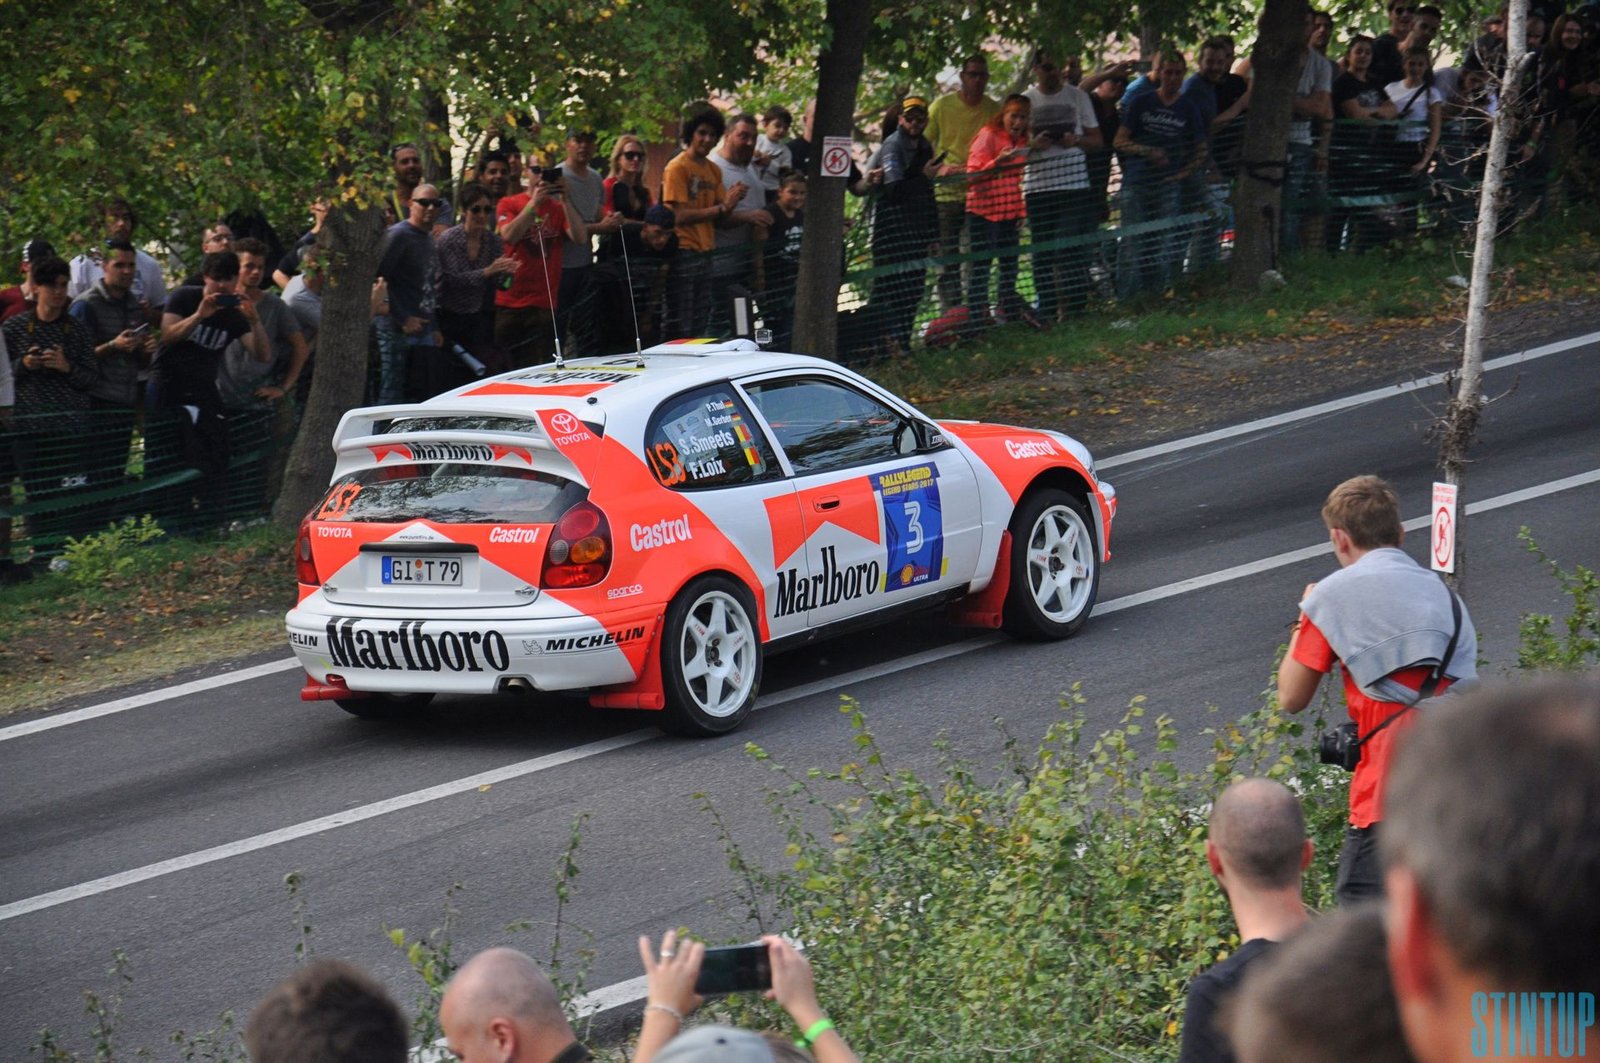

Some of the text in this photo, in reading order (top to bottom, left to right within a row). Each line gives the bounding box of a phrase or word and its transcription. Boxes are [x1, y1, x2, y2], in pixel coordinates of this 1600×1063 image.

[555, 432, 592, 446] TOYOTA
[678, 429, 735, 455] S.Smeets
[1005, 439, 1060, 459] Castrol
[411, 442, 493, 461] Marlboro
[689, 457, 726, 480] F.Loix
[317, 526, 352, 539] TOYOTA
[489, 527, 540, 543] Castrol
[629, 513, 692, 553] Castrol
[904, 501, 924, 555] 3
[392, 560, 413, 581] GI
[425, 561, 435, 581] T
[440, 561, 460, 582] 79
[774, 545, 880, 619] Marlboro
[607, 584, 644, 600] sparco
[325, 617, 510, 673] Marlboro
[545, 626, 646, 652] MICHELIN
